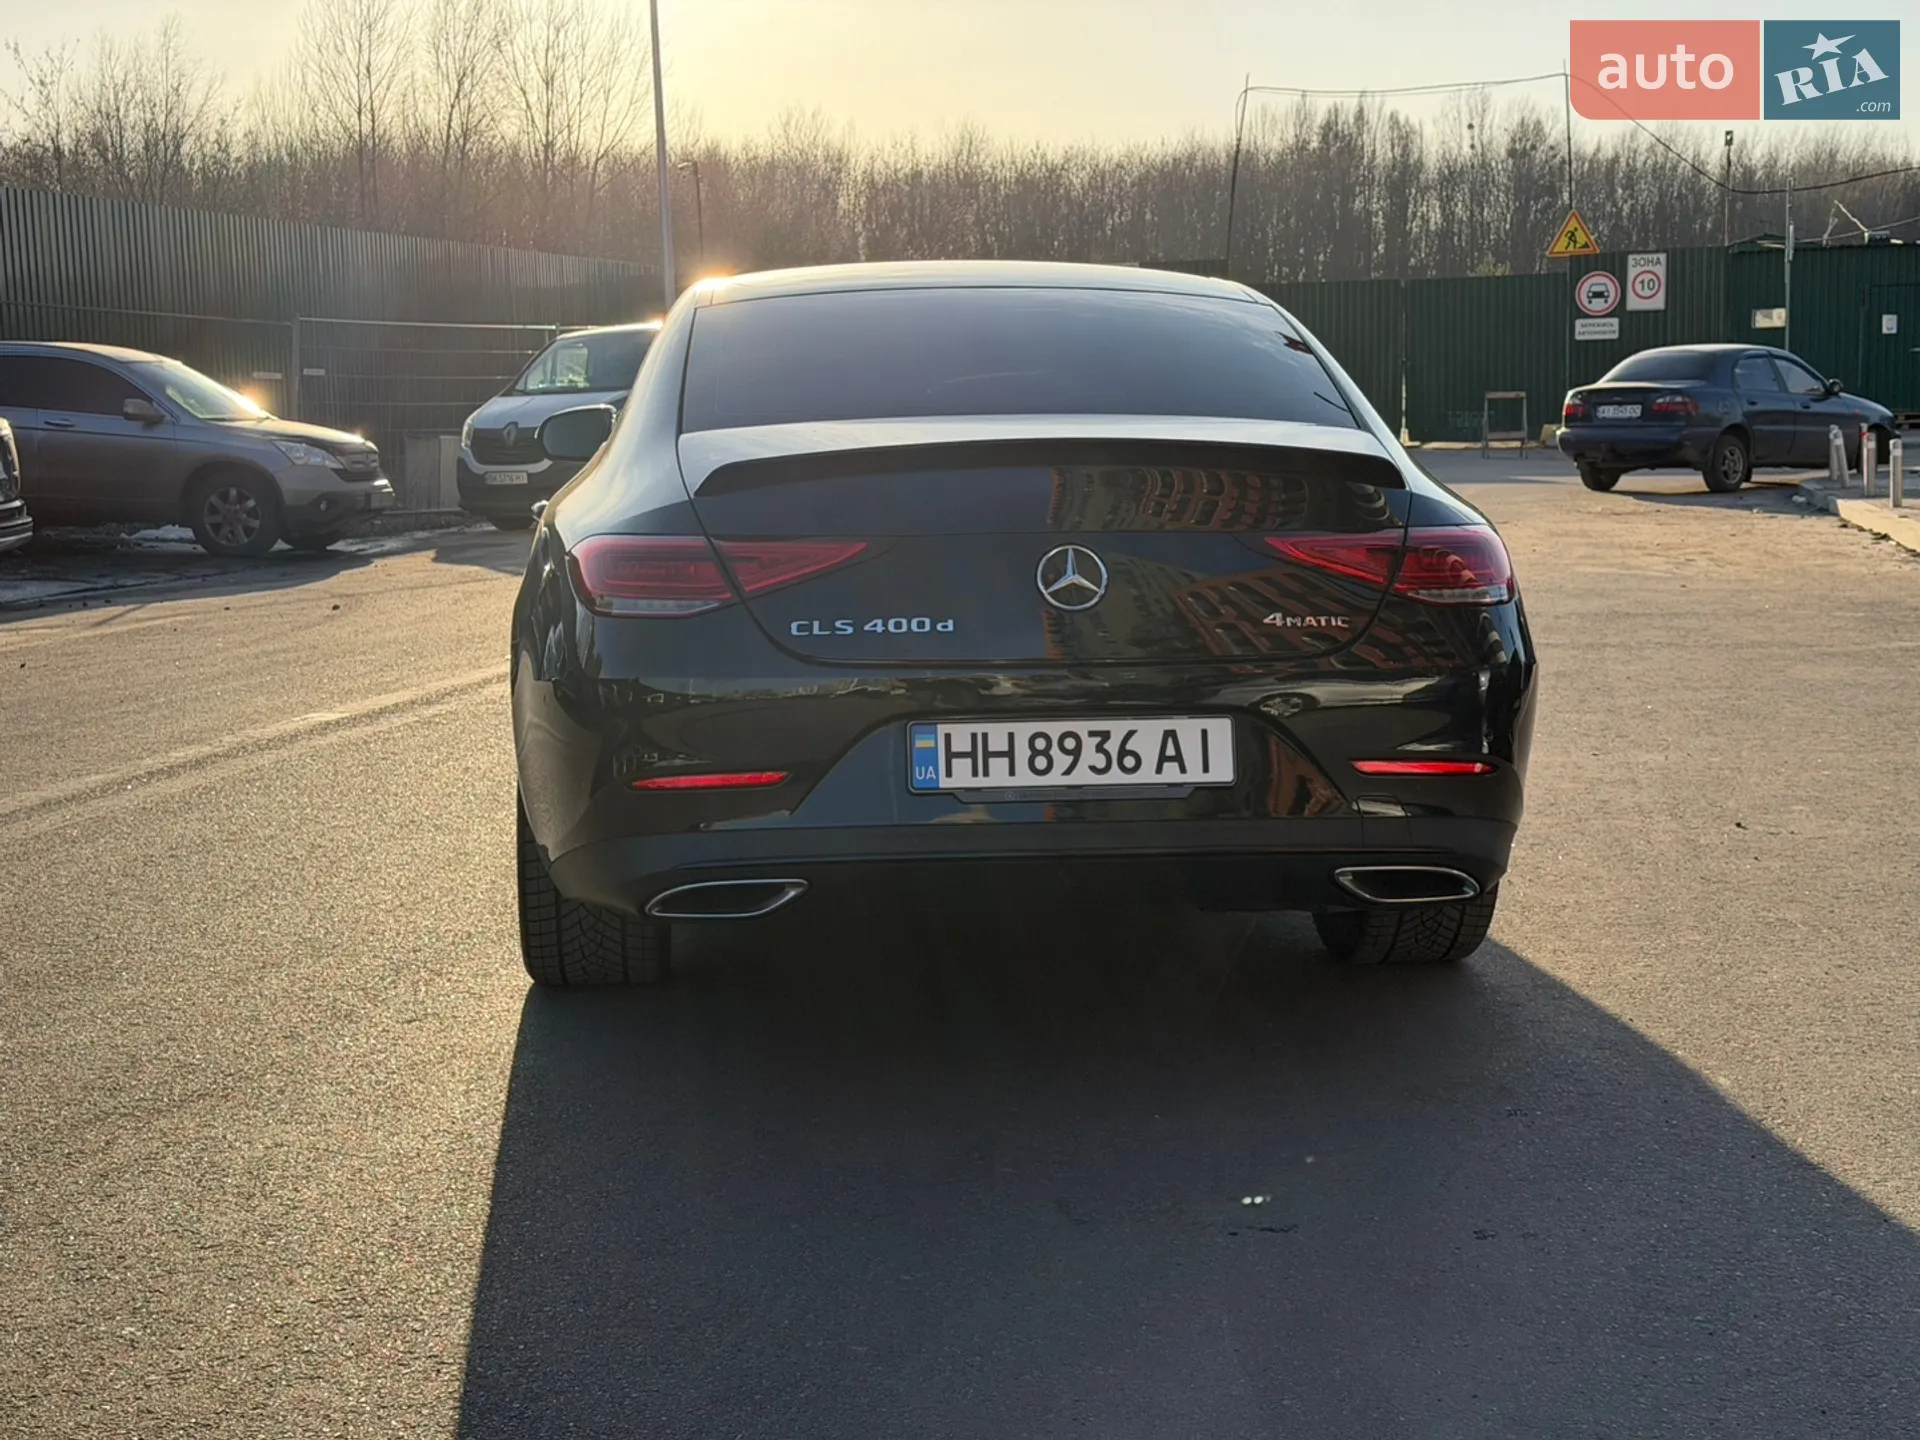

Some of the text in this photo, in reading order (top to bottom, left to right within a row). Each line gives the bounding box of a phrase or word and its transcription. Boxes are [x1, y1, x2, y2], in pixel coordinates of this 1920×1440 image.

[1631, 255, 1663, 268] ЗОНА
[1638, 278, 1656, 292] 10
[790, 619, 855, 636] CLS
[1263, 612, 1350, 628] 4MATIC
[915, 765, 937, 780] UA
